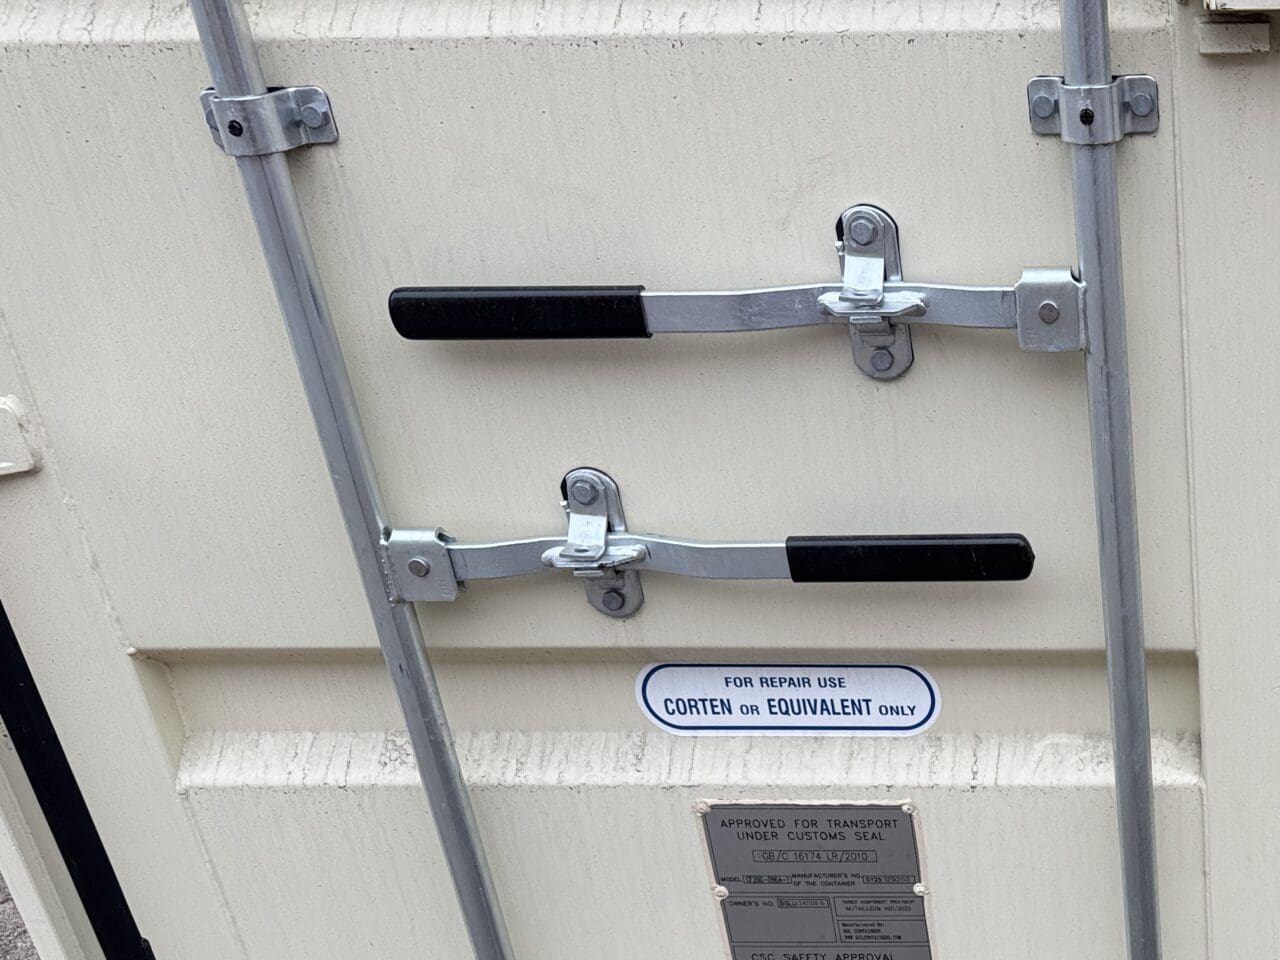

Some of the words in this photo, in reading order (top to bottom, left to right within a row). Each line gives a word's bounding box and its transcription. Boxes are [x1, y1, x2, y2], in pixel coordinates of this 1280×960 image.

[724, 676, 753, 688] FOR
[760, 676, 811, 688] REPAIR
[818, 677, 846, 688] USE
[664, 698, 732, 716] CORTEN
[740, 704, 760, 715] OR
[767, 698, 872, 716] EQUIVALENT
[878, 704, 916, 716] ONLY
[720, 819, 786, 829] APPROVED
[794, 819, 818, 829] FOR
[827, 819, 898, 829] TRANSPORT
[737, 831, 779, 841] UNDER
[787, 831, 846, 841] CUSTOMS
[854, 831, 885, 841] SEAL
[762, 851, 789, 862] GB/C
[793, 852, 821, 861] 16174
[826, 851, 868, 862] LR/2010
